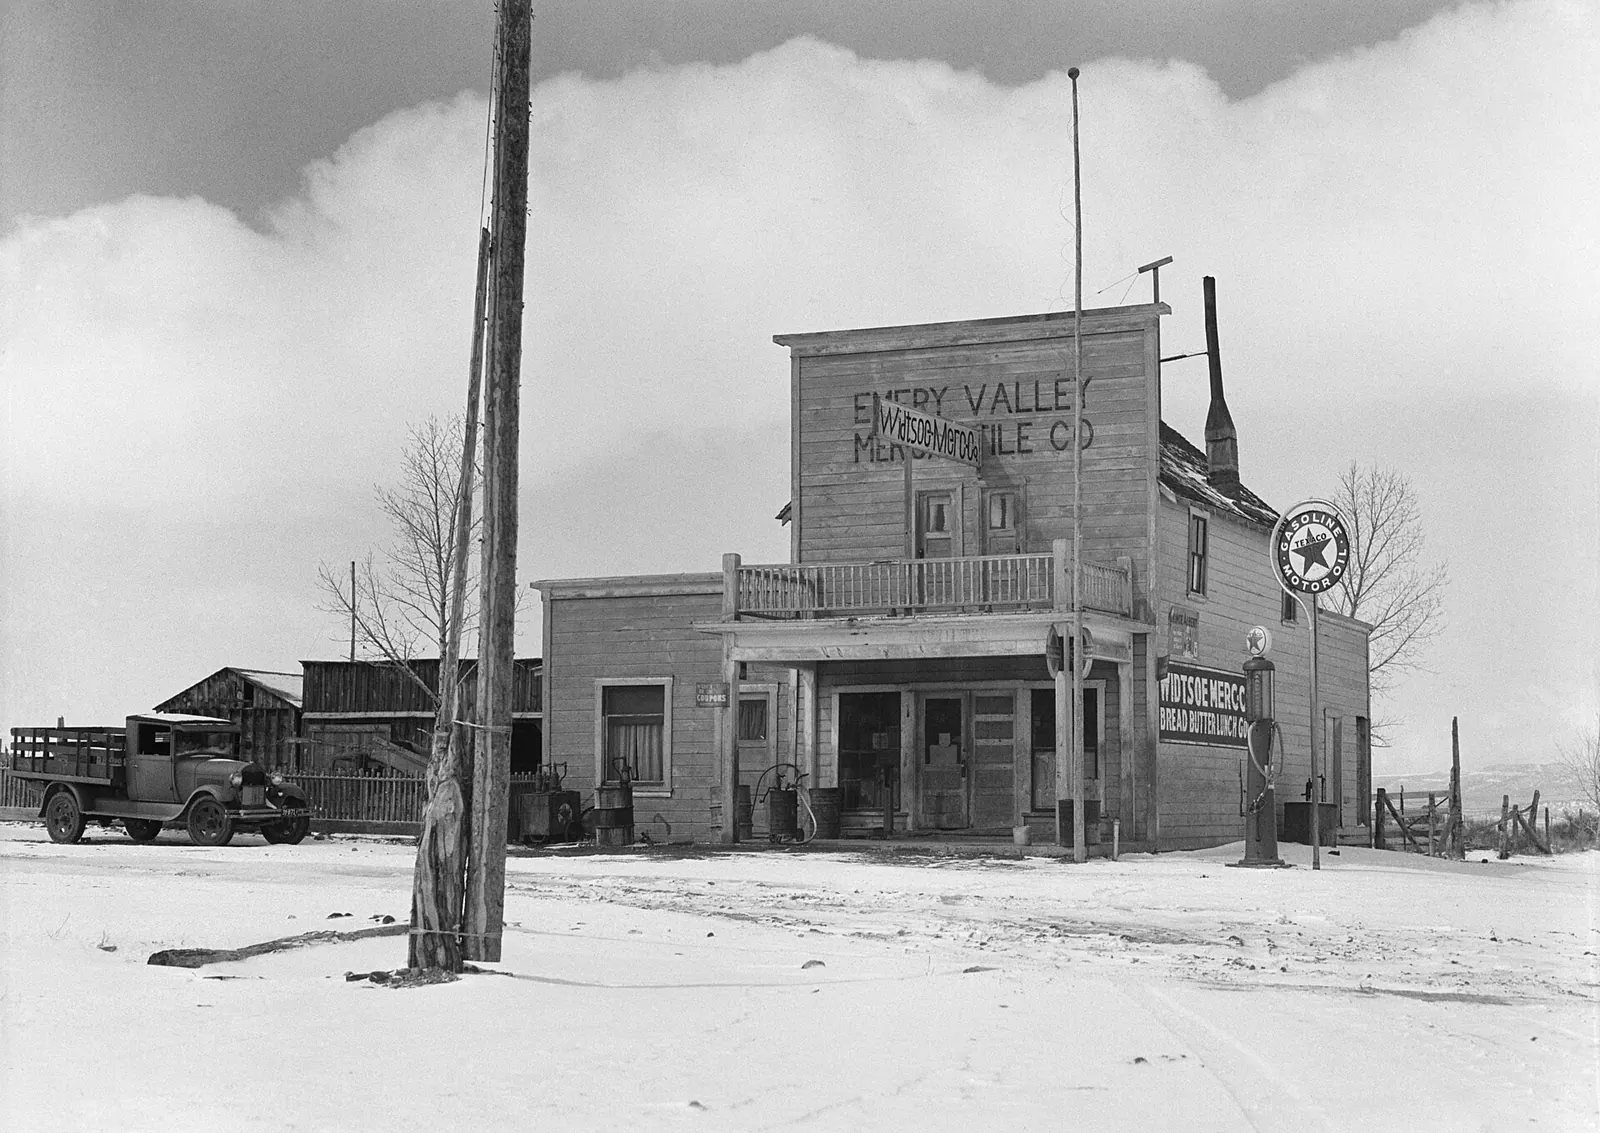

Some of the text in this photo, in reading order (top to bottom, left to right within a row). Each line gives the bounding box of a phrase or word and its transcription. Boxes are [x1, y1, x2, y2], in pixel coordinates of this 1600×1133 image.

[854, 376, 1092, 424] ERY VALLEY
[1281, 513, 1342, 551] GASOLINE
[1294, 533, 1327, 548] TEXACO
[1283, 548, 1347, 591] MOTOR OIL
[1160, 672, 1208, 707] WIDTSOE
[1160, 707, 1187, 732] BREAD
[1189, 710, 1216, 735] BUTTER
[1217, 713, 1238, 737] LUNCH
